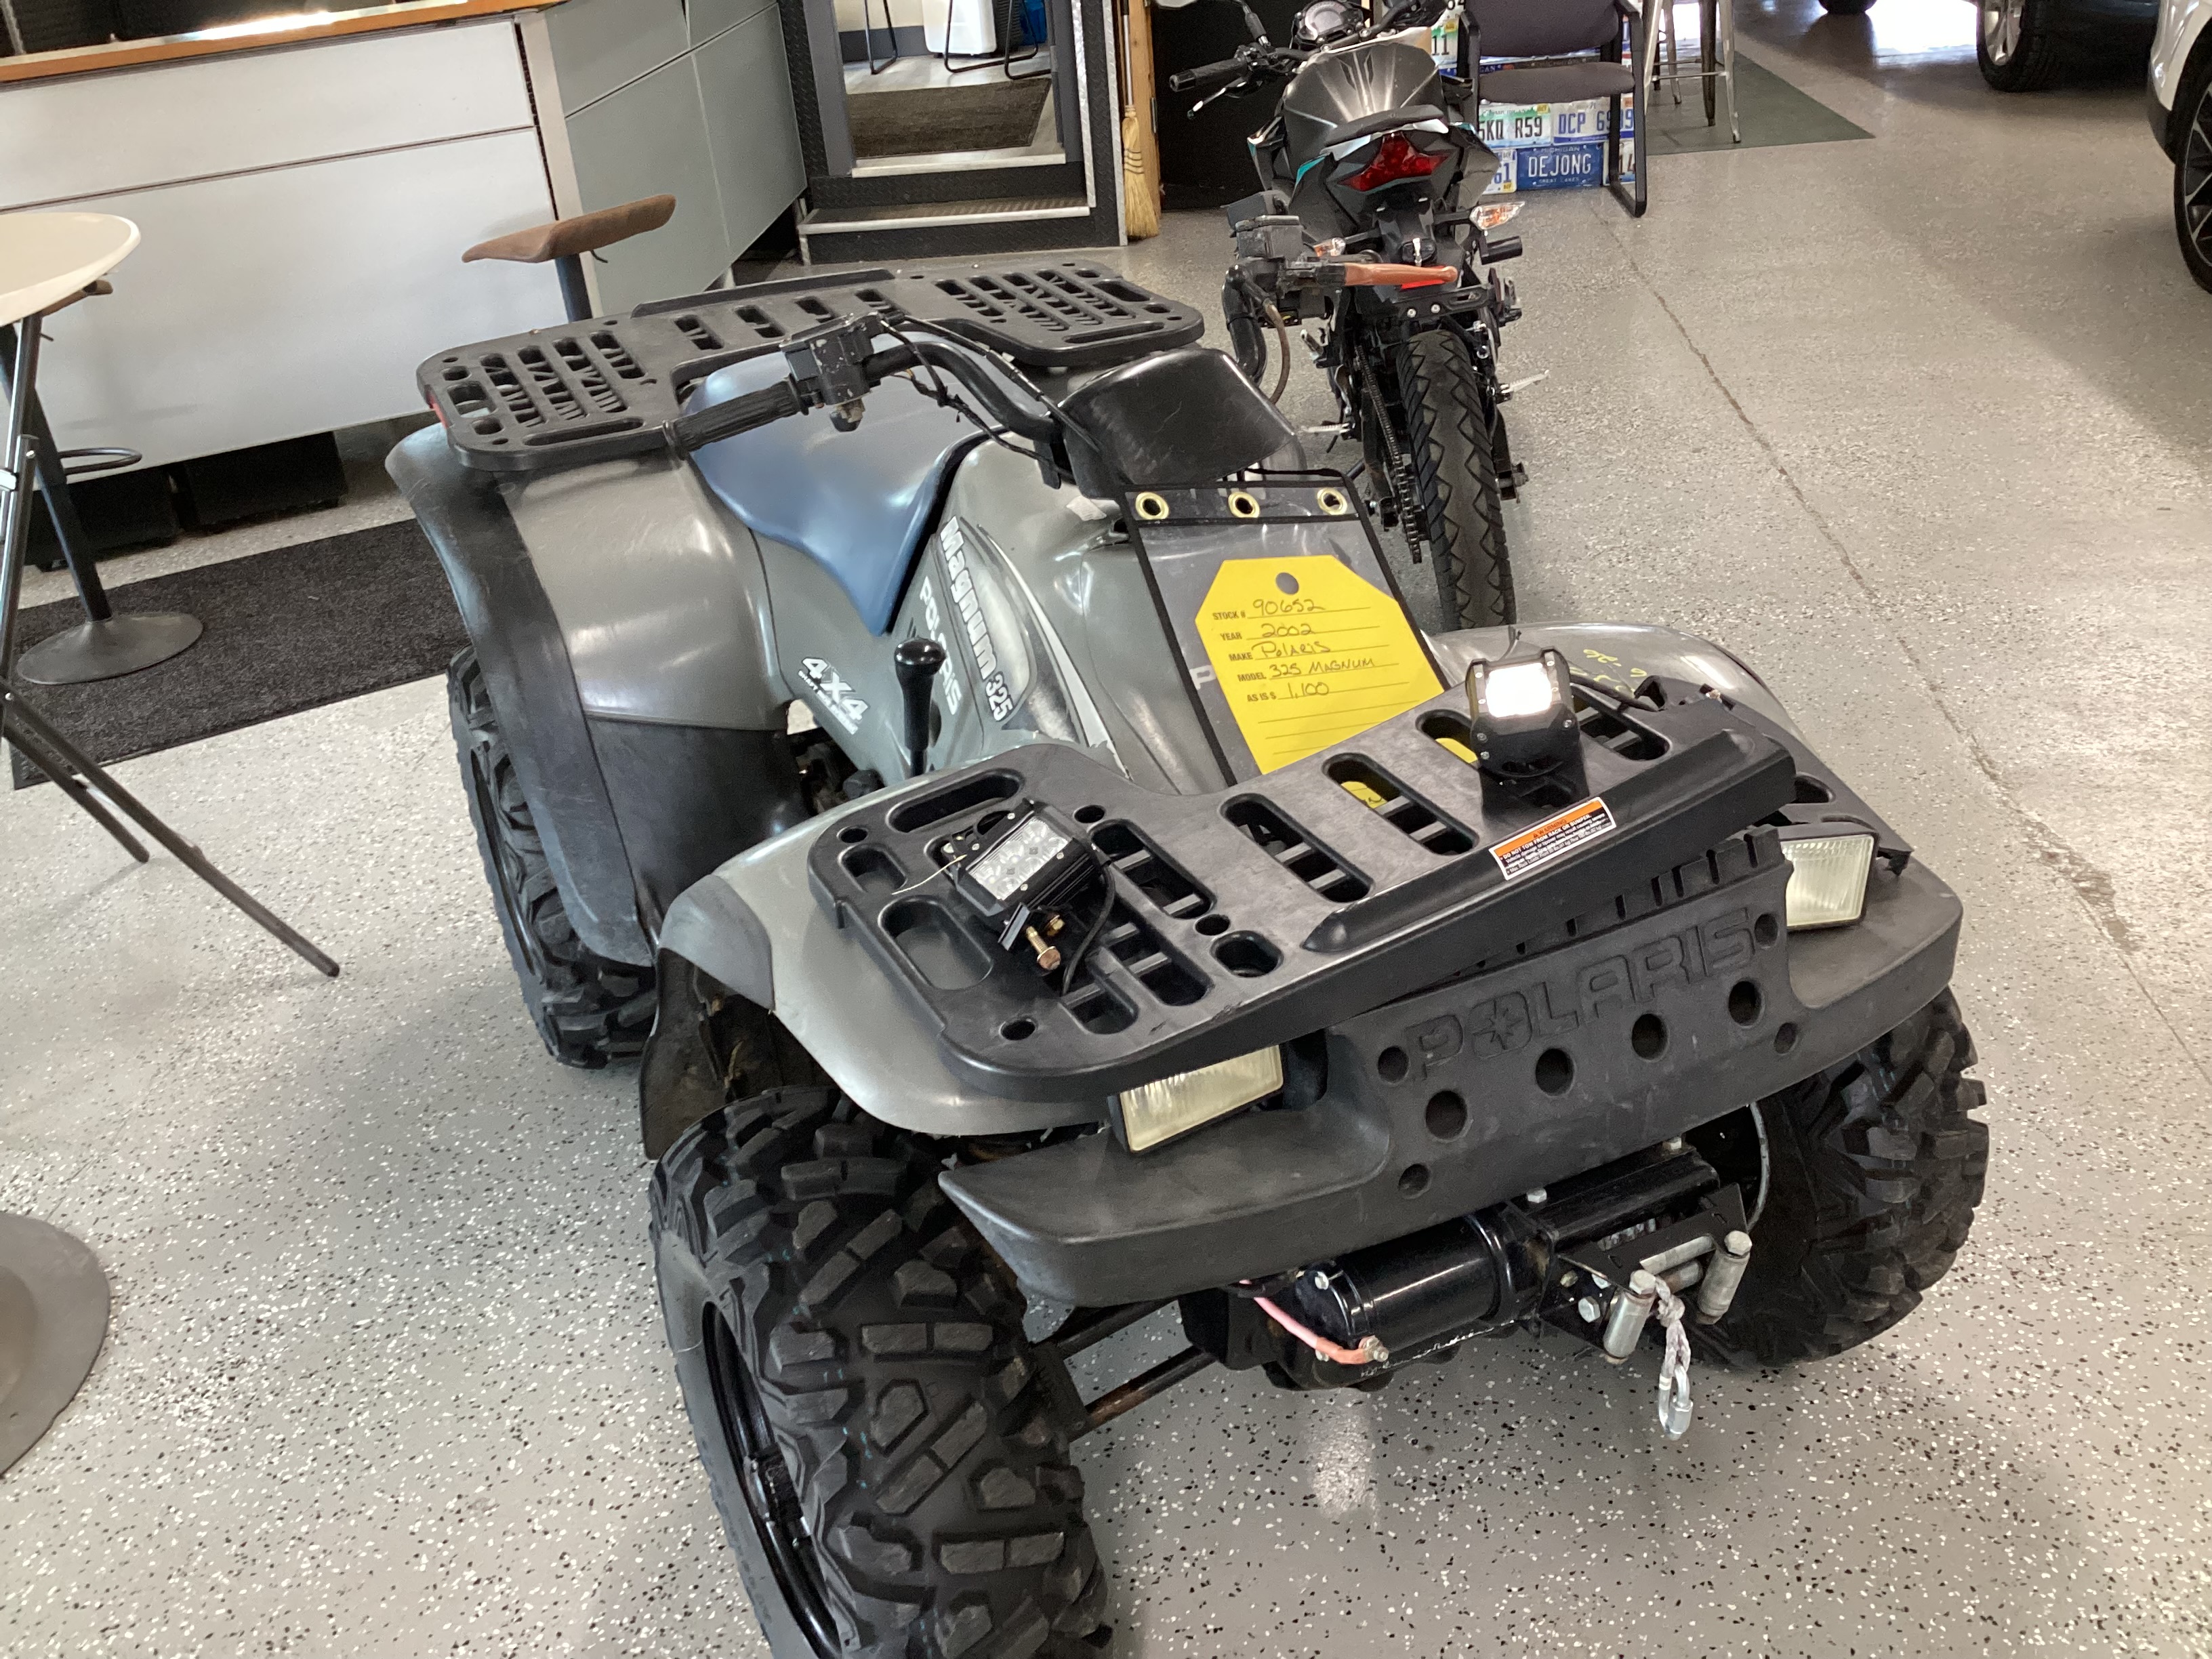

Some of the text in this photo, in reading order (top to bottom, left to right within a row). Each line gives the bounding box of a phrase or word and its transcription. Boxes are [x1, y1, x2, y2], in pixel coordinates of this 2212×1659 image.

[1515, 116, 1542, 138] R59
[1528, 153, 1591, 178] DEJONG
[1212, 611, 1238, 621] STOCK
[1252, 598, 1326, 615] 90652
[1220, 623, 1315, 641] YEAR 2002
[1228, 652, 1254, 662] MAKE
[1237, 657, 1375, 682] MODEL 325 MAGNUM
[985, 673, 1013, 721] 325
[1247, 693, 1258, 702] AS
[1259, 692, 1268, 701] IS
[1537, 818, 1567, 835] WARNING
[1511, 846, 1521, 855] NOT
[1521, 841, 1534, 850] TOW
[1533, 834, 1548, 844] FROM
[1547, 827, 1562, 837] RACK
[1404, 907, 1757, 1081] POLARIS
